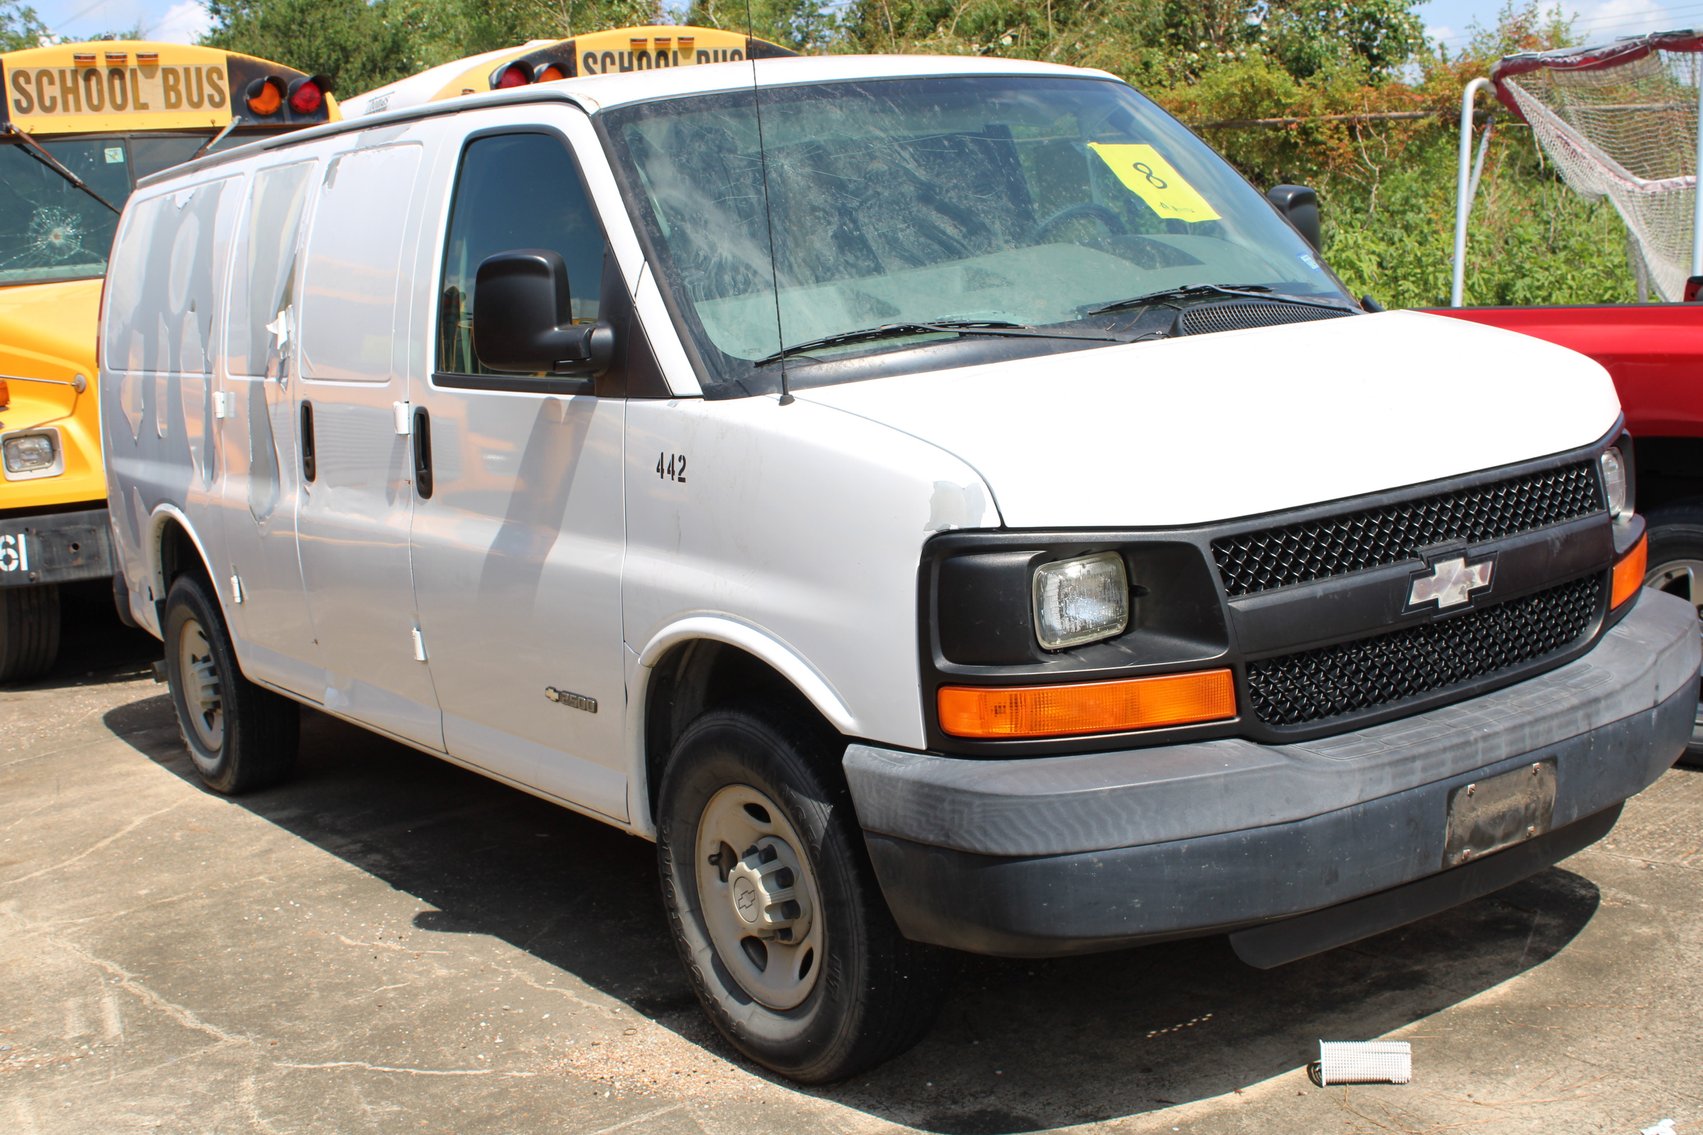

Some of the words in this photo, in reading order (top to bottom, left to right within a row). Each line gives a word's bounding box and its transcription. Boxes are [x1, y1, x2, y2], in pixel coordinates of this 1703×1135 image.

[11, 67, 149, 115] SCHOOL
[161, 66, 226, 110] BUS
[1133, 162, 1167, 189] 8
[656, 452, 686, 483] 442
